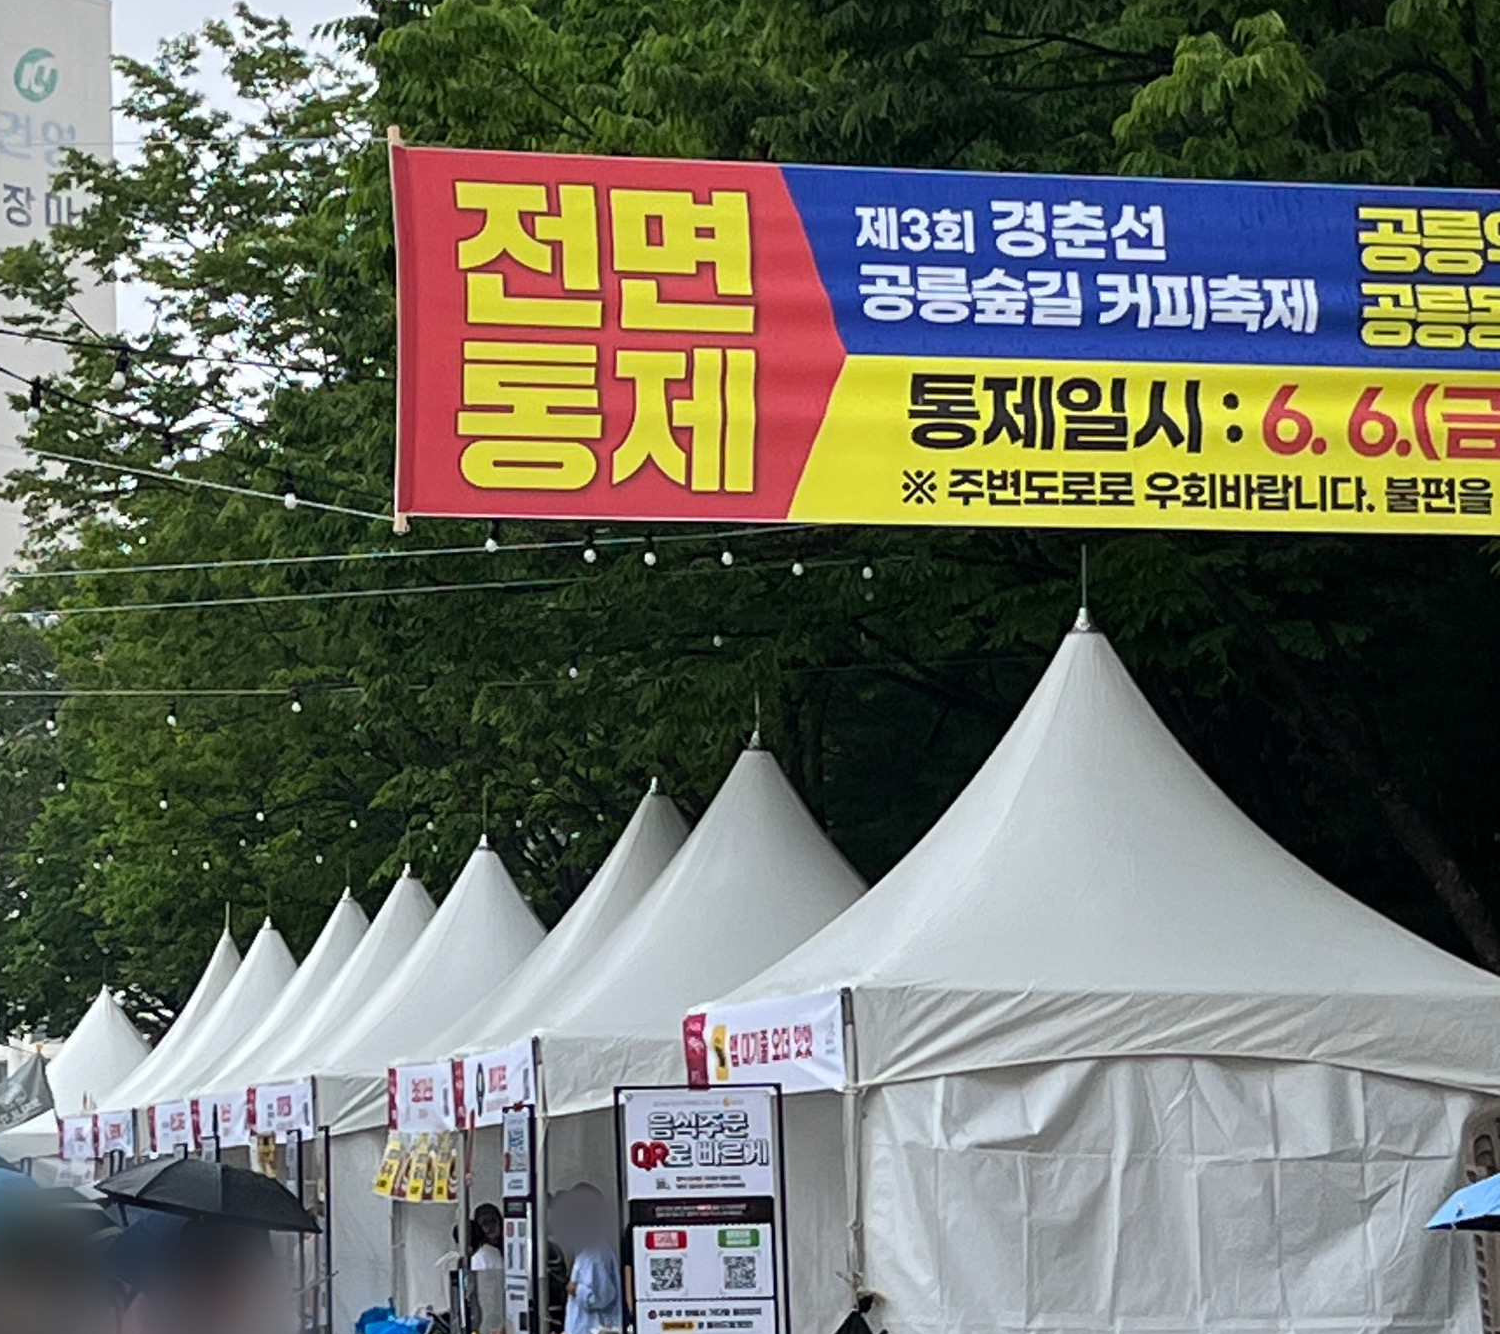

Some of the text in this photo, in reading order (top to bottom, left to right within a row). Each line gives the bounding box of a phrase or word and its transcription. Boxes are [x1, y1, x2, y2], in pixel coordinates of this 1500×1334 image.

[453, 180, 756, 336] 전면
[855, 199, 1168, 263] 제3회 경춘선
[858, 264, 1319, 334] 공릉숲길 커피축제
[455, 341, 756, 494] 통제
[947, 469, 1135, 507] 주변도로로
[1143, 471, 1376, 514] 우회바랍니다.
[1384, 475, 1494, 516] 불편을
[648, 1110, 749, 1140] 음식주문
